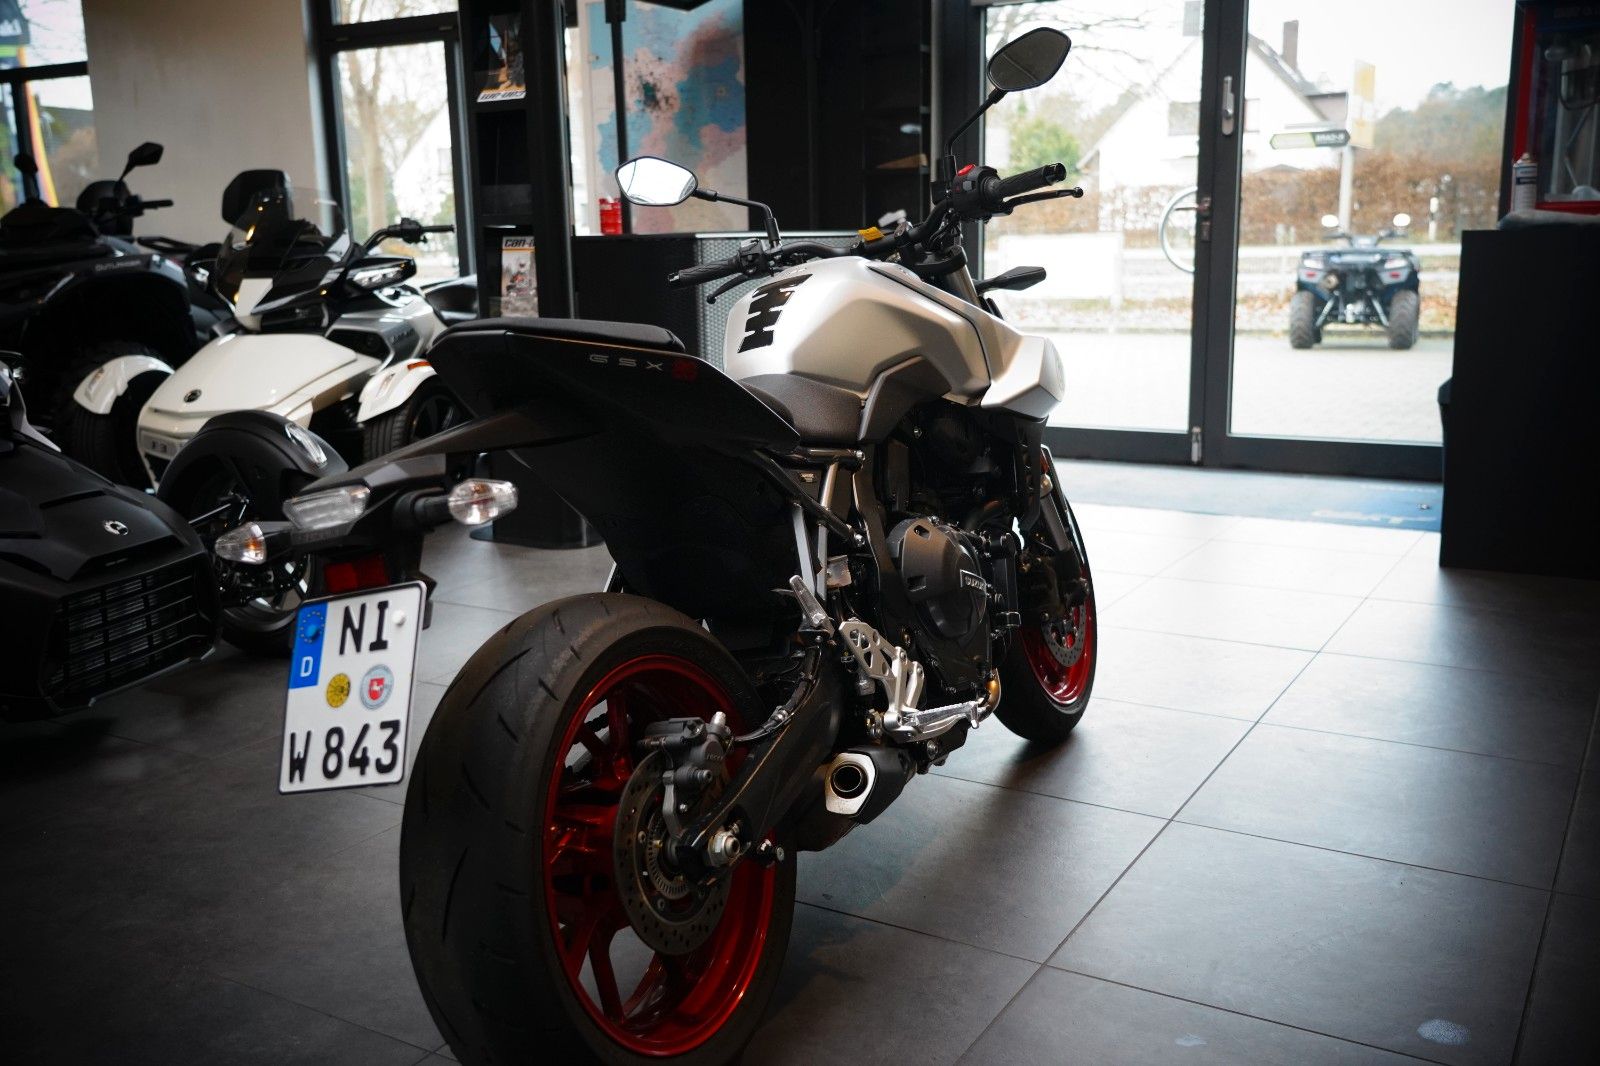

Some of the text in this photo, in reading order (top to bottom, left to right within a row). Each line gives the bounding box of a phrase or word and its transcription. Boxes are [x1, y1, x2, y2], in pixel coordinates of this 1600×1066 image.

[504, 239, 536, 248] can-a
[339, 600, 390, 656] NI
[300, 655, 314, 678] D
[289, 719, 401, 784] W 843
